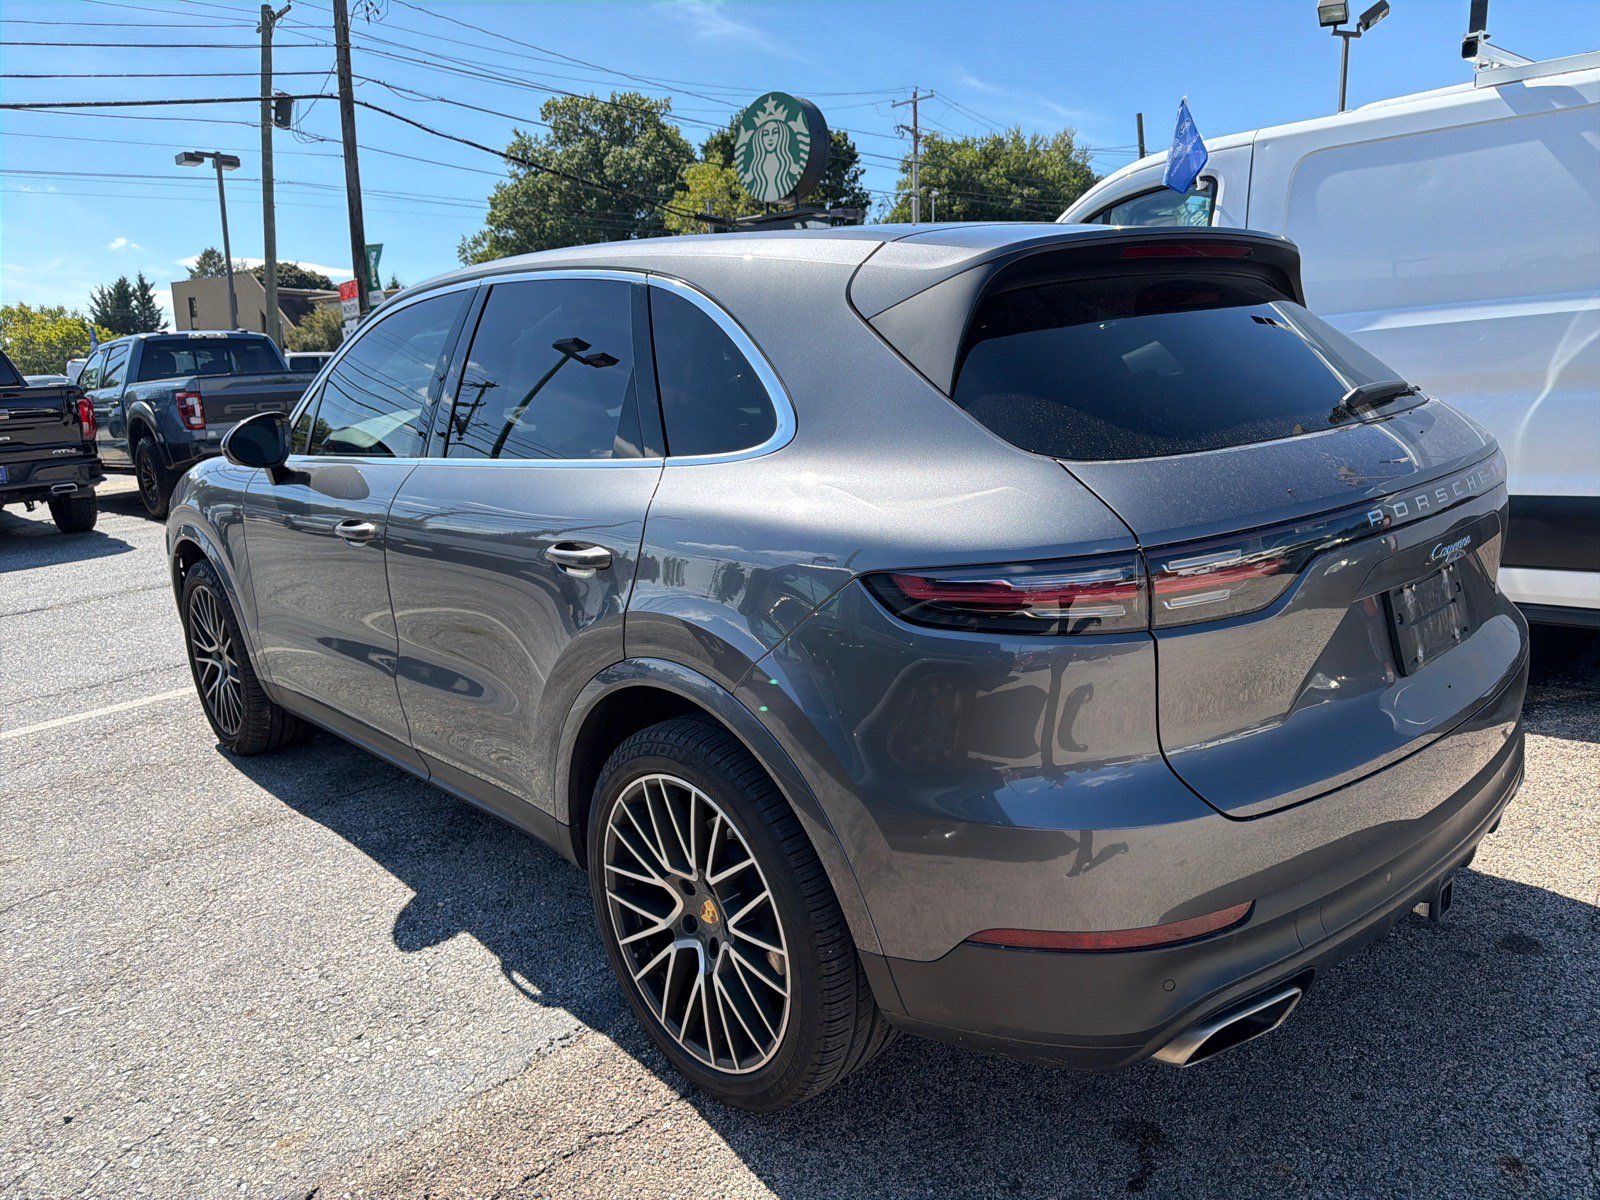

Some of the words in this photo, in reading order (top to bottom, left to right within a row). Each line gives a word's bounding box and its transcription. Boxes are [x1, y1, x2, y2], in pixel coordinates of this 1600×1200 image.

[1366, 471, 1490, 527] PORSCHE
[1431, 534, 1471, 562] Cayenne
[602, 742, 686, 779] SCORPION
